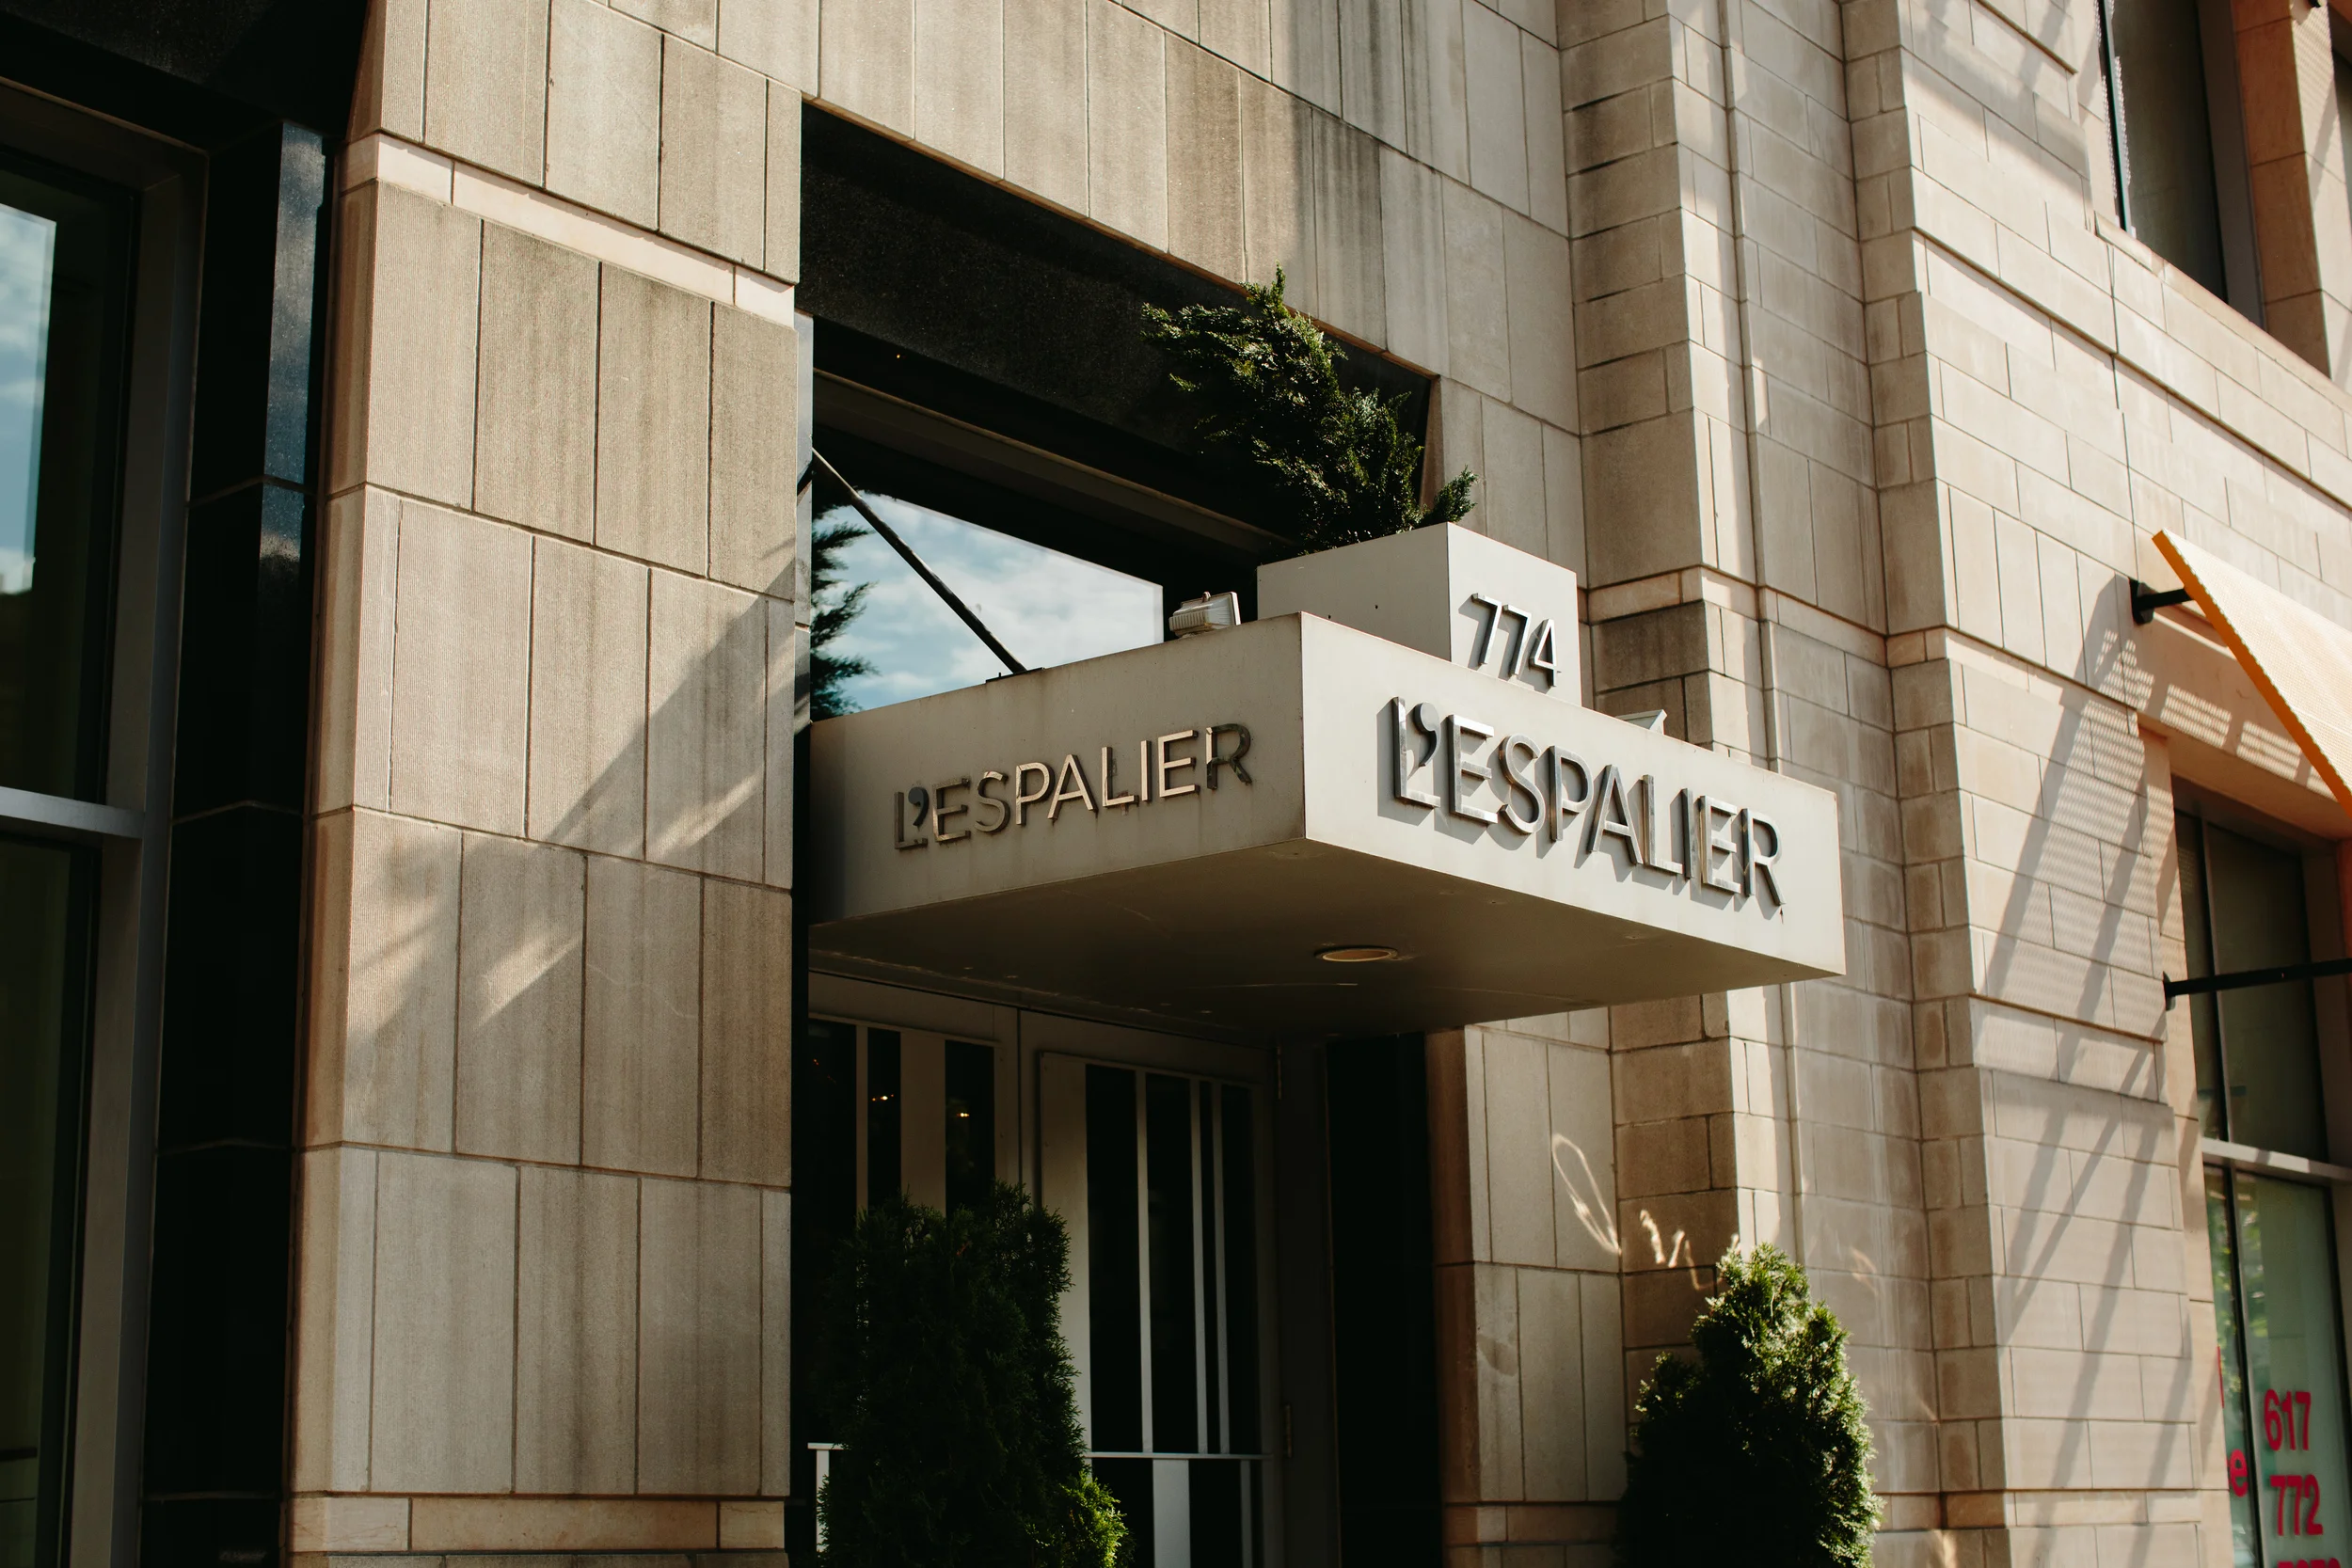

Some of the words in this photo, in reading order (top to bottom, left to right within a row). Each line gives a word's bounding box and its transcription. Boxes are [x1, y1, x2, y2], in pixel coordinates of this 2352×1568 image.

[1471, 593, 1560, 688] 774
[894, 723, 1252, 849] L'ESPALIER
[1392, 696, 1785, 906] L'ESPALIER
[2264, 1389, 2312, 1450] 617
[2270, 1474, 2324, 1536] 772
